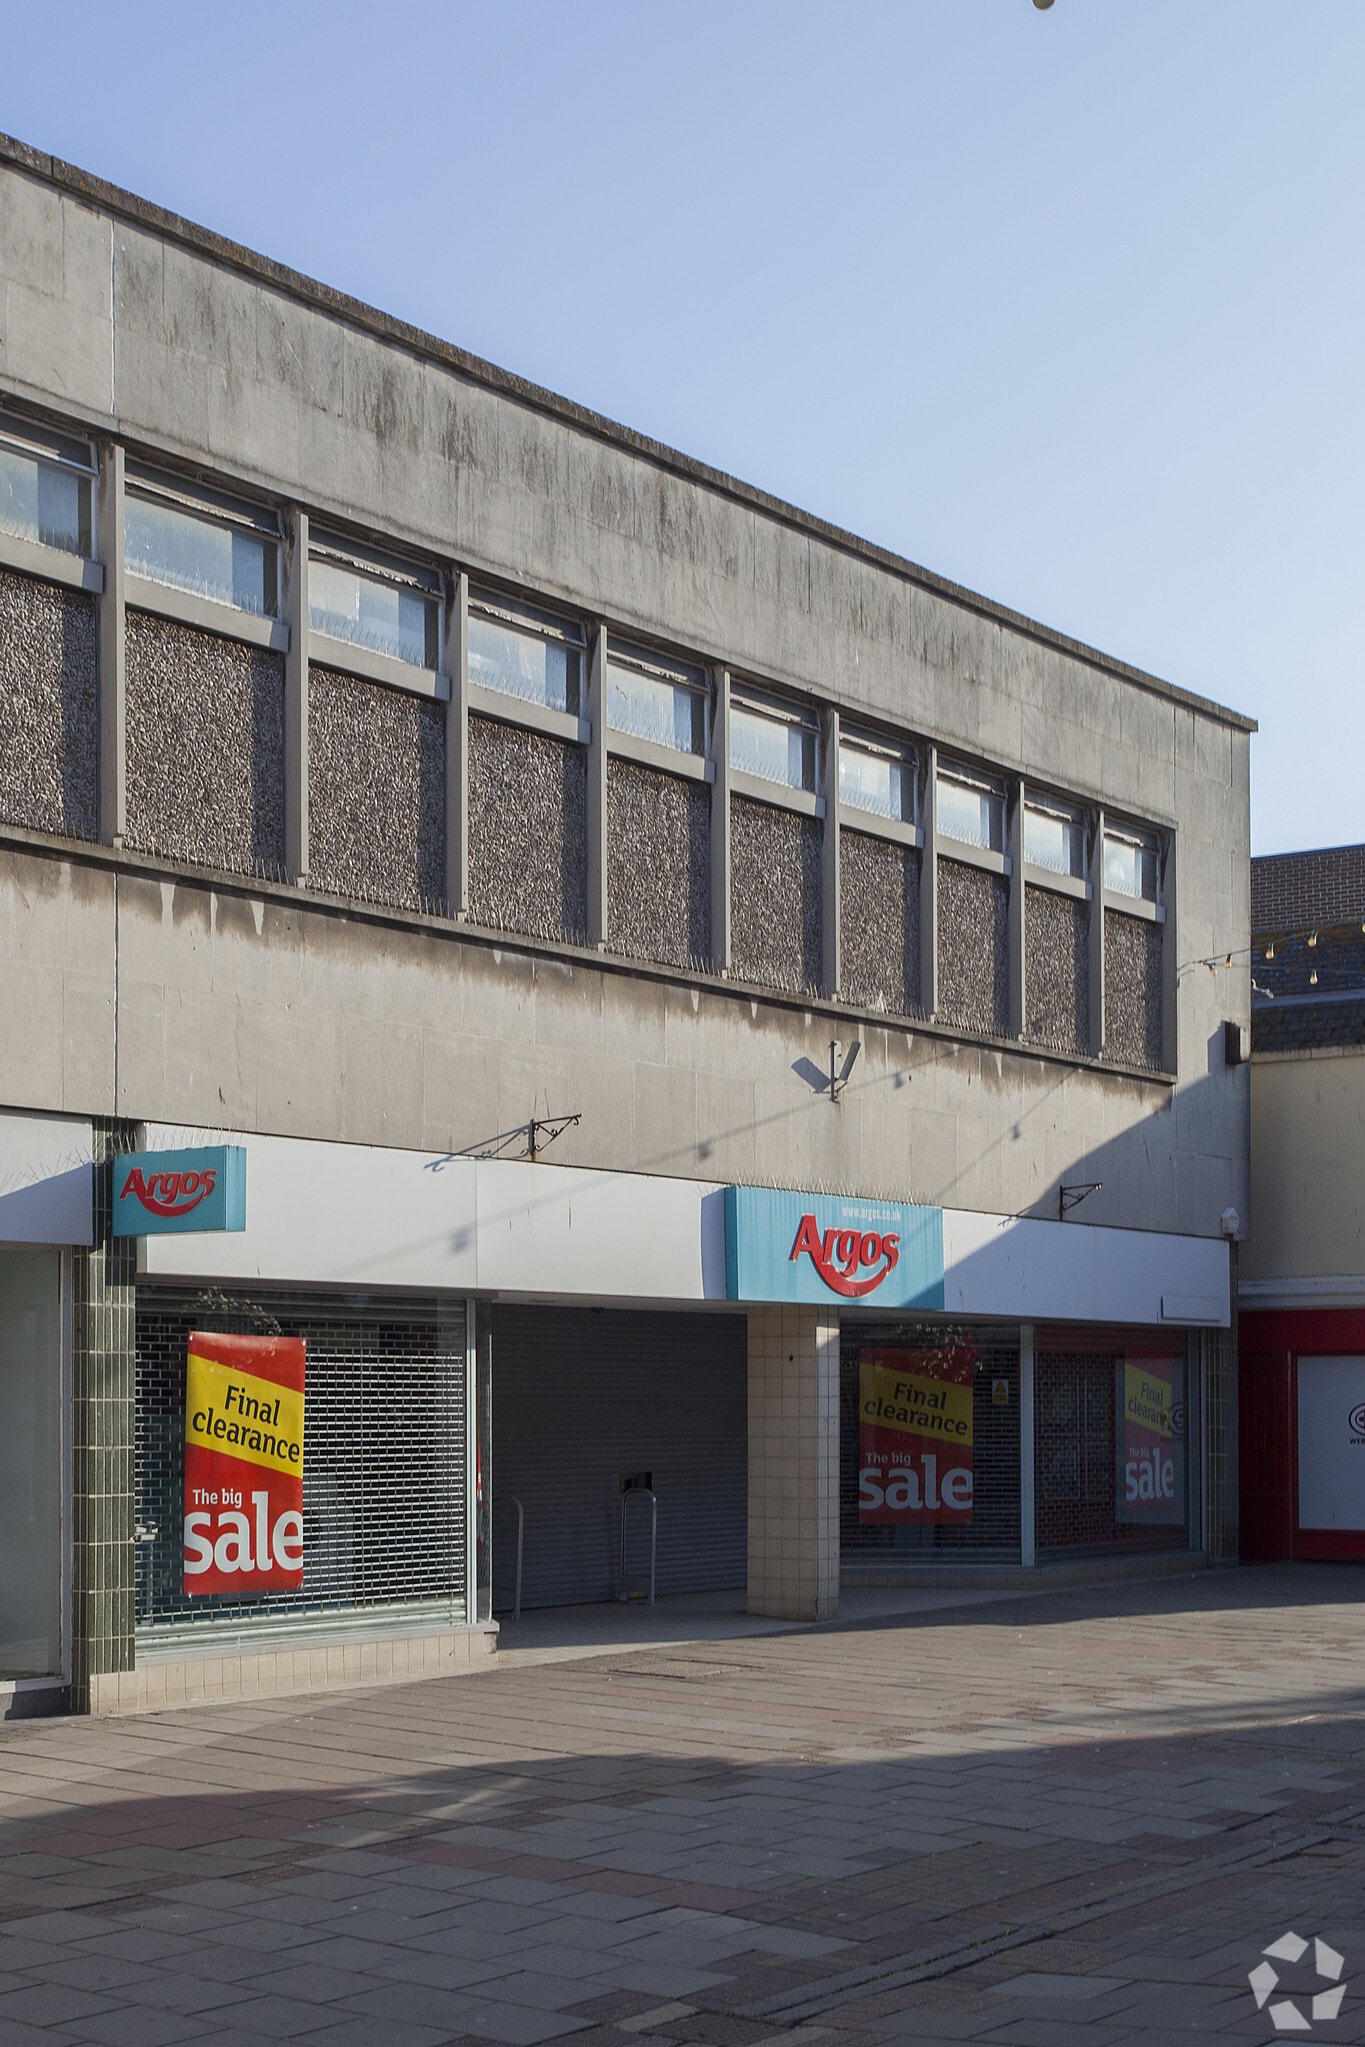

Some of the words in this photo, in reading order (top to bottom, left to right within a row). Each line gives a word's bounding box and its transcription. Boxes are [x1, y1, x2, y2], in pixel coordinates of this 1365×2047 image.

[120, 1167, 217, 1218] Argos
[841, 1206, 901, 1222] www.argos.co.uk
[789, 1212, 900, 1298] Argos
[224, 1385, 281, 1426] Final
[893, 1382, 947, 1411] Final
[1140, 1382, 1163, 1406] Final
[192, 1407, 300, 1463] clearance
[864, 1398, 969, 1436] clearance
[865, 1452, 889, 1464] The
[891, 1452, 911, 1467] big
[1129, 1447, 1140, 1458] The
[1140, 1447, 1150, 1460] big
[859, 1454, 973, 1510] sale
[1125, 1447, 1174, 1501] sale
[192, 1489, 219, 1505] The
[221, 1488, 242, 1509] big
[183, 1491, 304, 1574] sale
